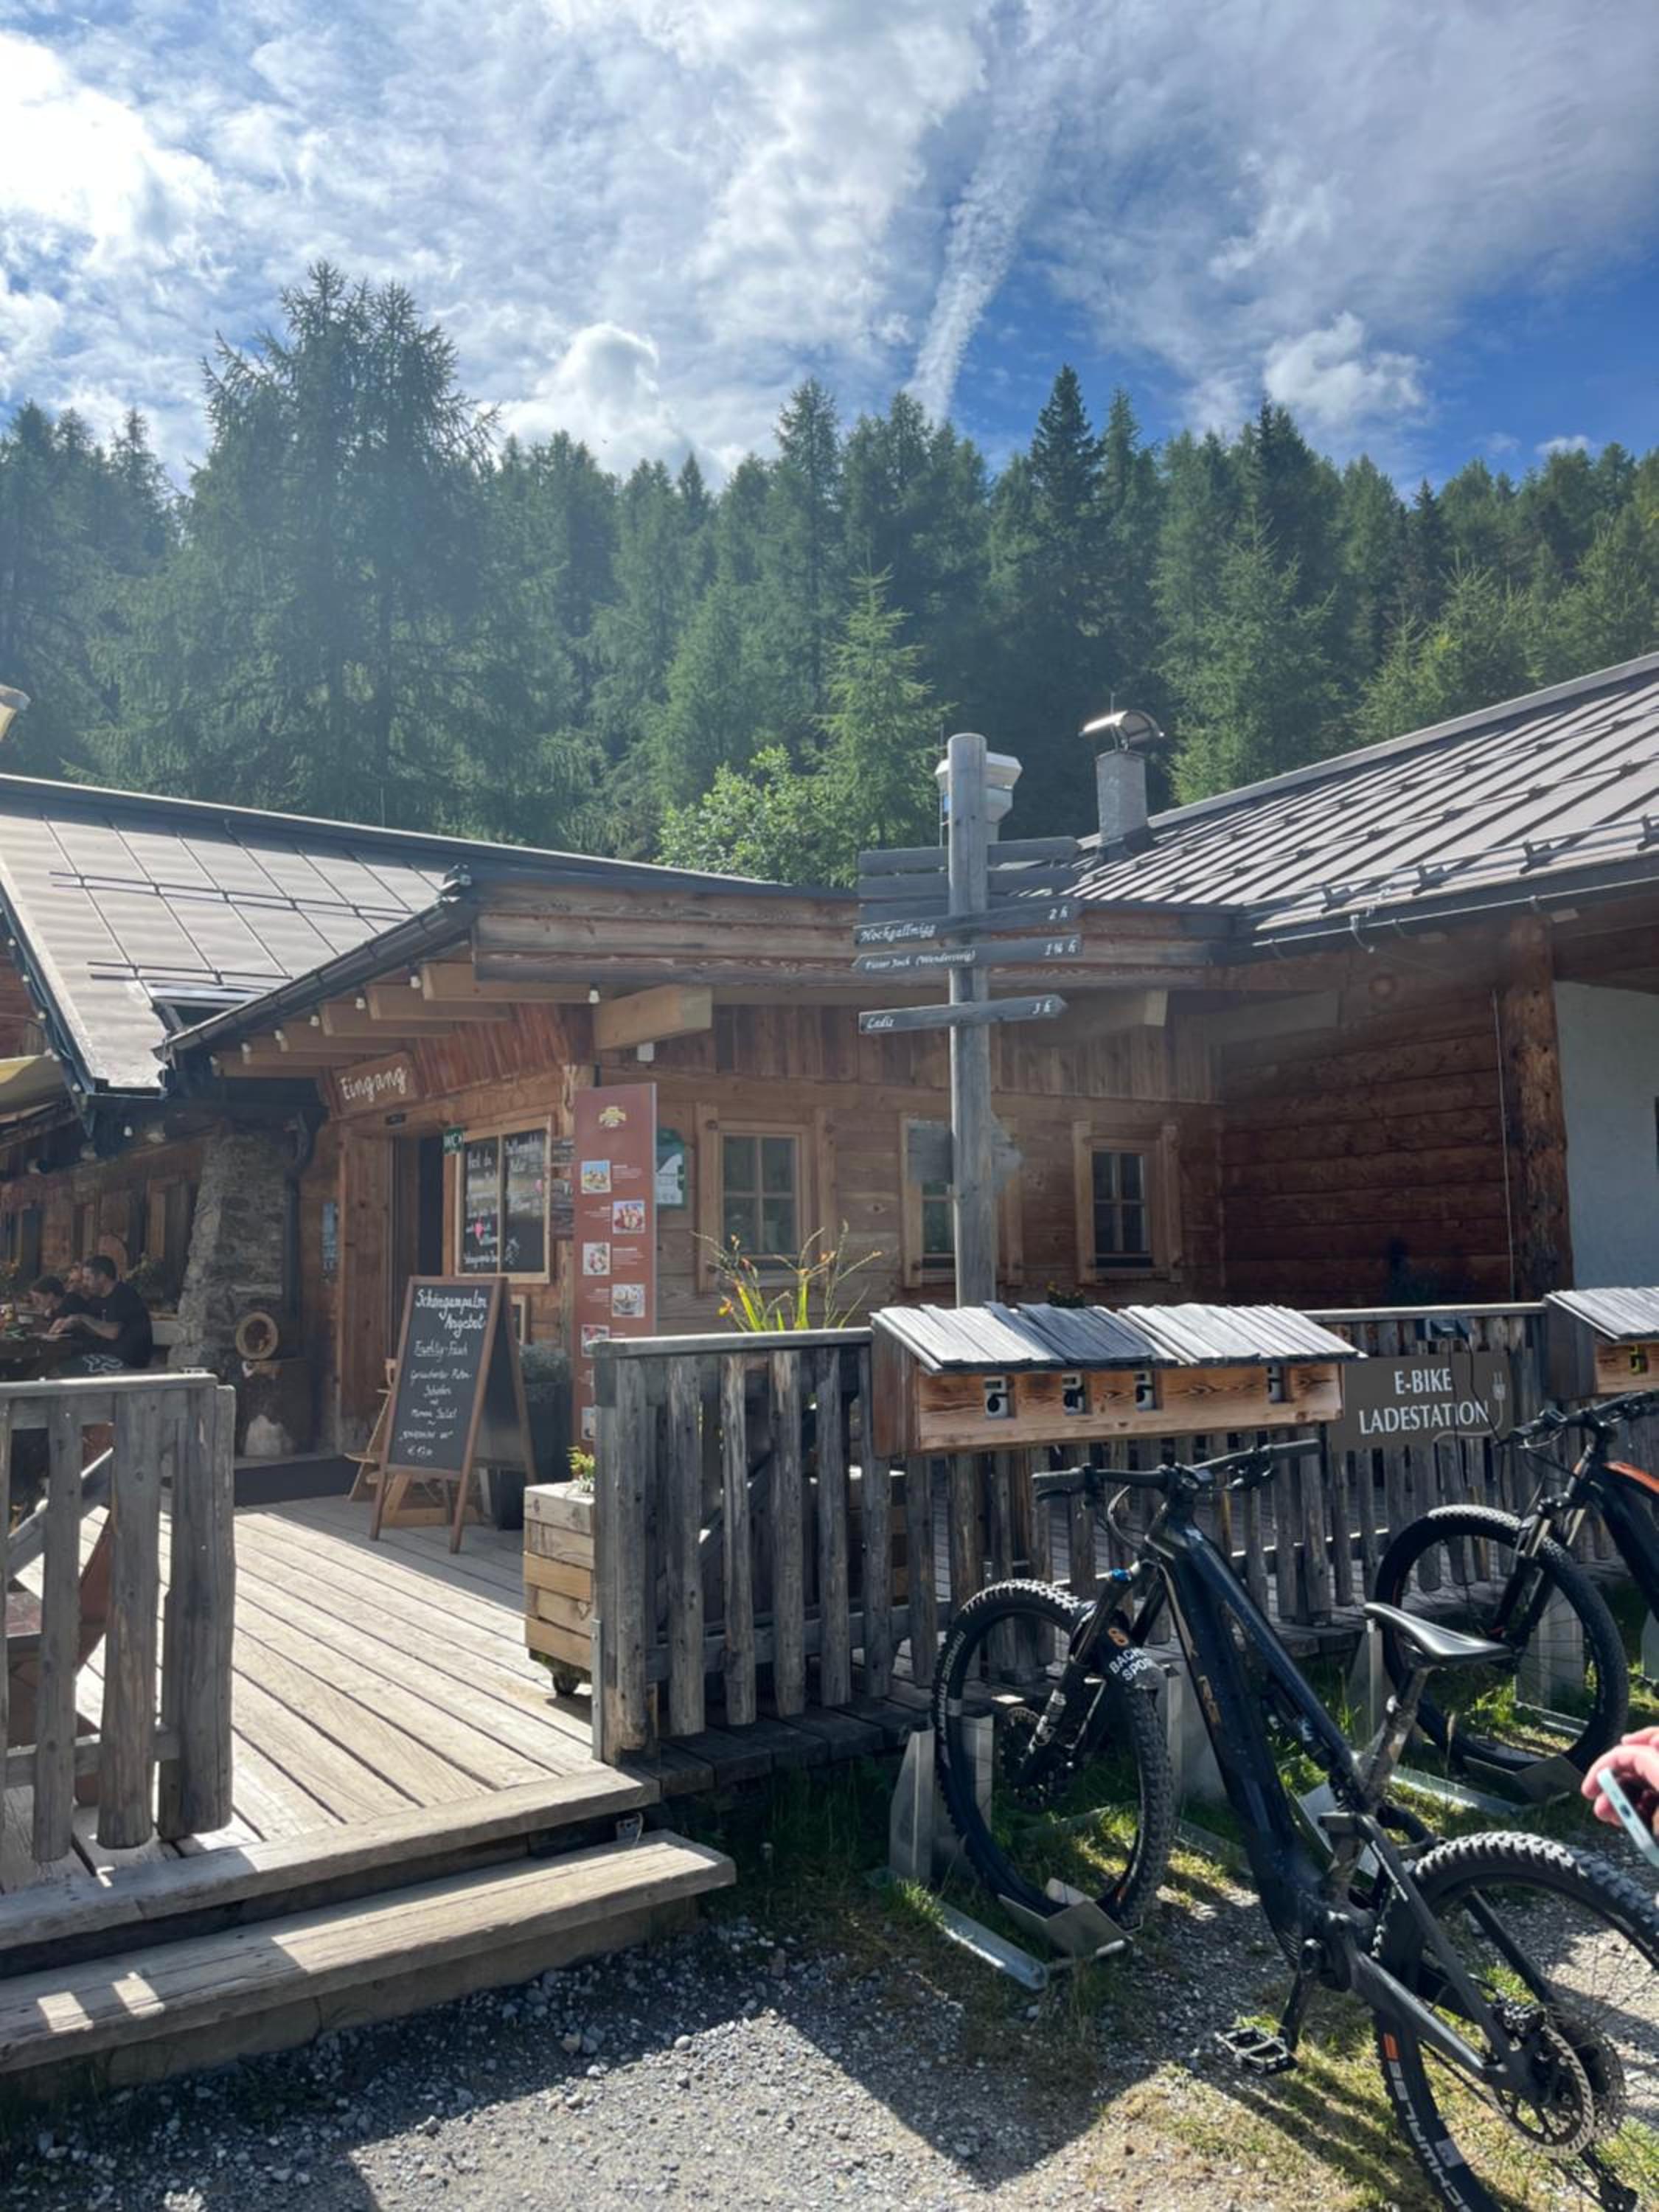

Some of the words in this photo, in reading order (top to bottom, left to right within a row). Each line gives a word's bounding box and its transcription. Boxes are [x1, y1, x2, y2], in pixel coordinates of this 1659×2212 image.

[1048, 908, 1057, 920] 2
[341, 1066, 407, 1102] Eingang
[1394, 1368, 1453, 1395] E-BIKE
[1358, 1399, 1489, 1434] LADESTATION
